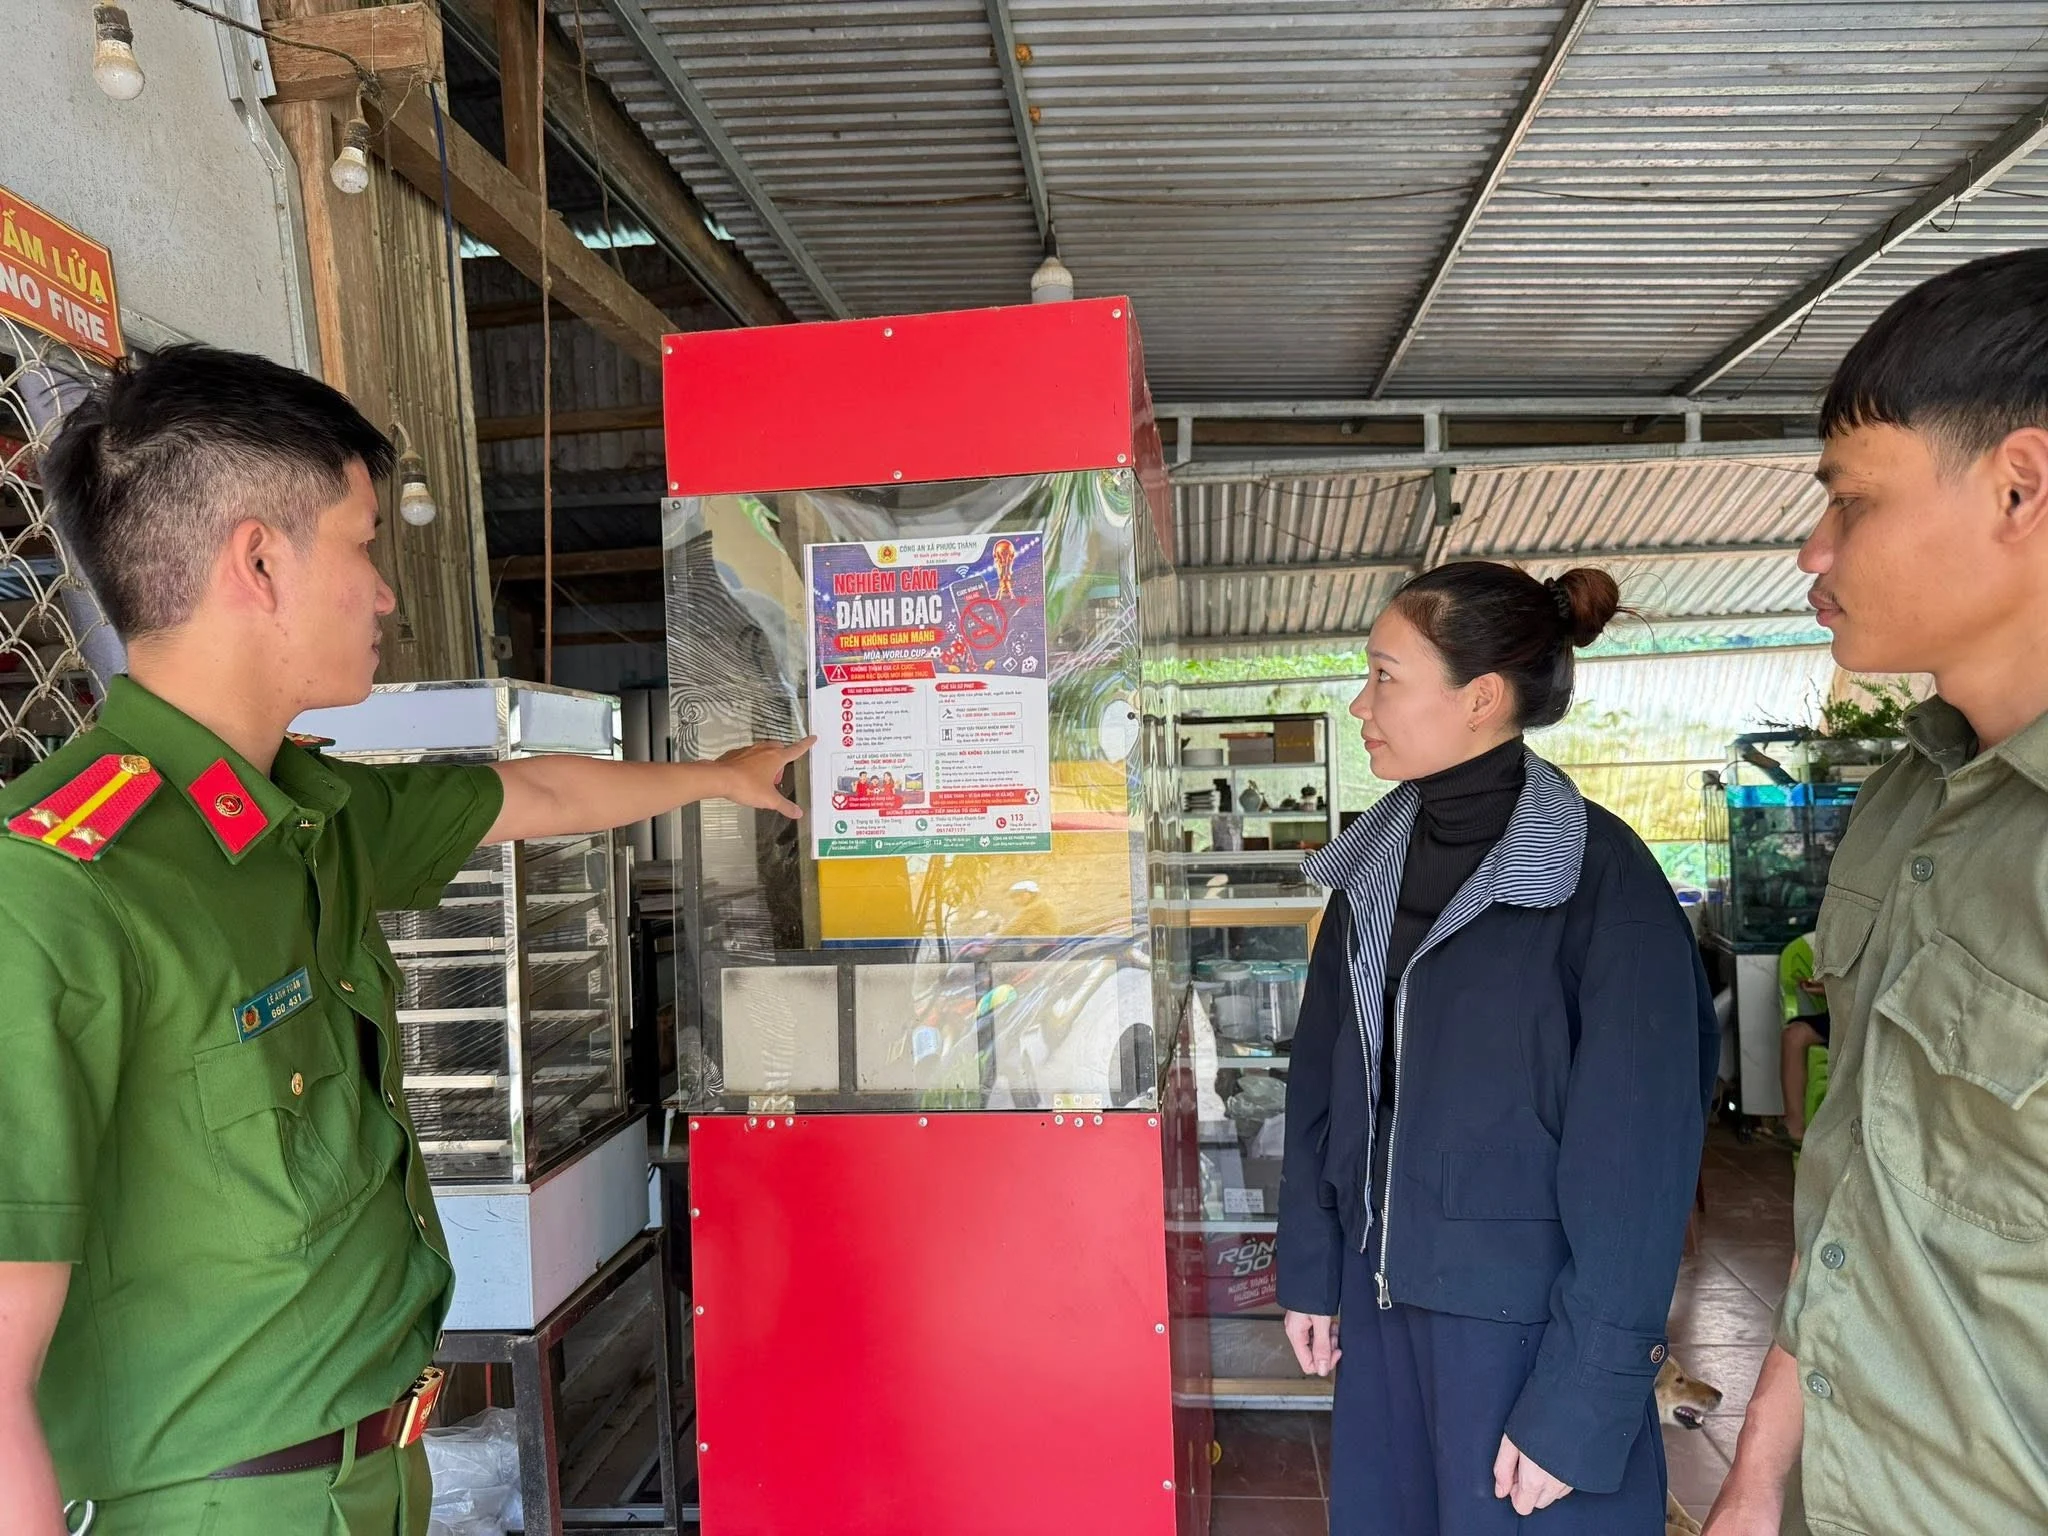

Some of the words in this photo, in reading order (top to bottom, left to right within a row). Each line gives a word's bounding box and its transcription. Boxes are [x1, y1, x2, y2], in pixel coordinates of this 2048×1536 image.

[0, 208, 47, 268] ẤM
[52, 248, 109, 304] LỬA
[0, 262, 41, 308] NO
[47, 287, 110, 347] FIRE
[917, 543, 926, 552] AN
[833, 569, 896, 595] NGHIÊM
[901, 566, 939, 592] CẤM
[837, 595, 895, 629] ĐÁNH
[901, 595, 942, 629] BẠC
[840, 635, 859, 648] TRÊN
[861, 633, 889, 647] KHÔNG
[890, 632, 909, 646] GIAN
[911, 630, 935, 644] MẠNG
[864, 650, 882, 660] MÙA
[882, 648, 910, 659] WORLD
[910, 648, 926, 658] CUP
[1010, 814, 1024, 822] 113
[1217, 1237, 1278, 1265] RỒN
